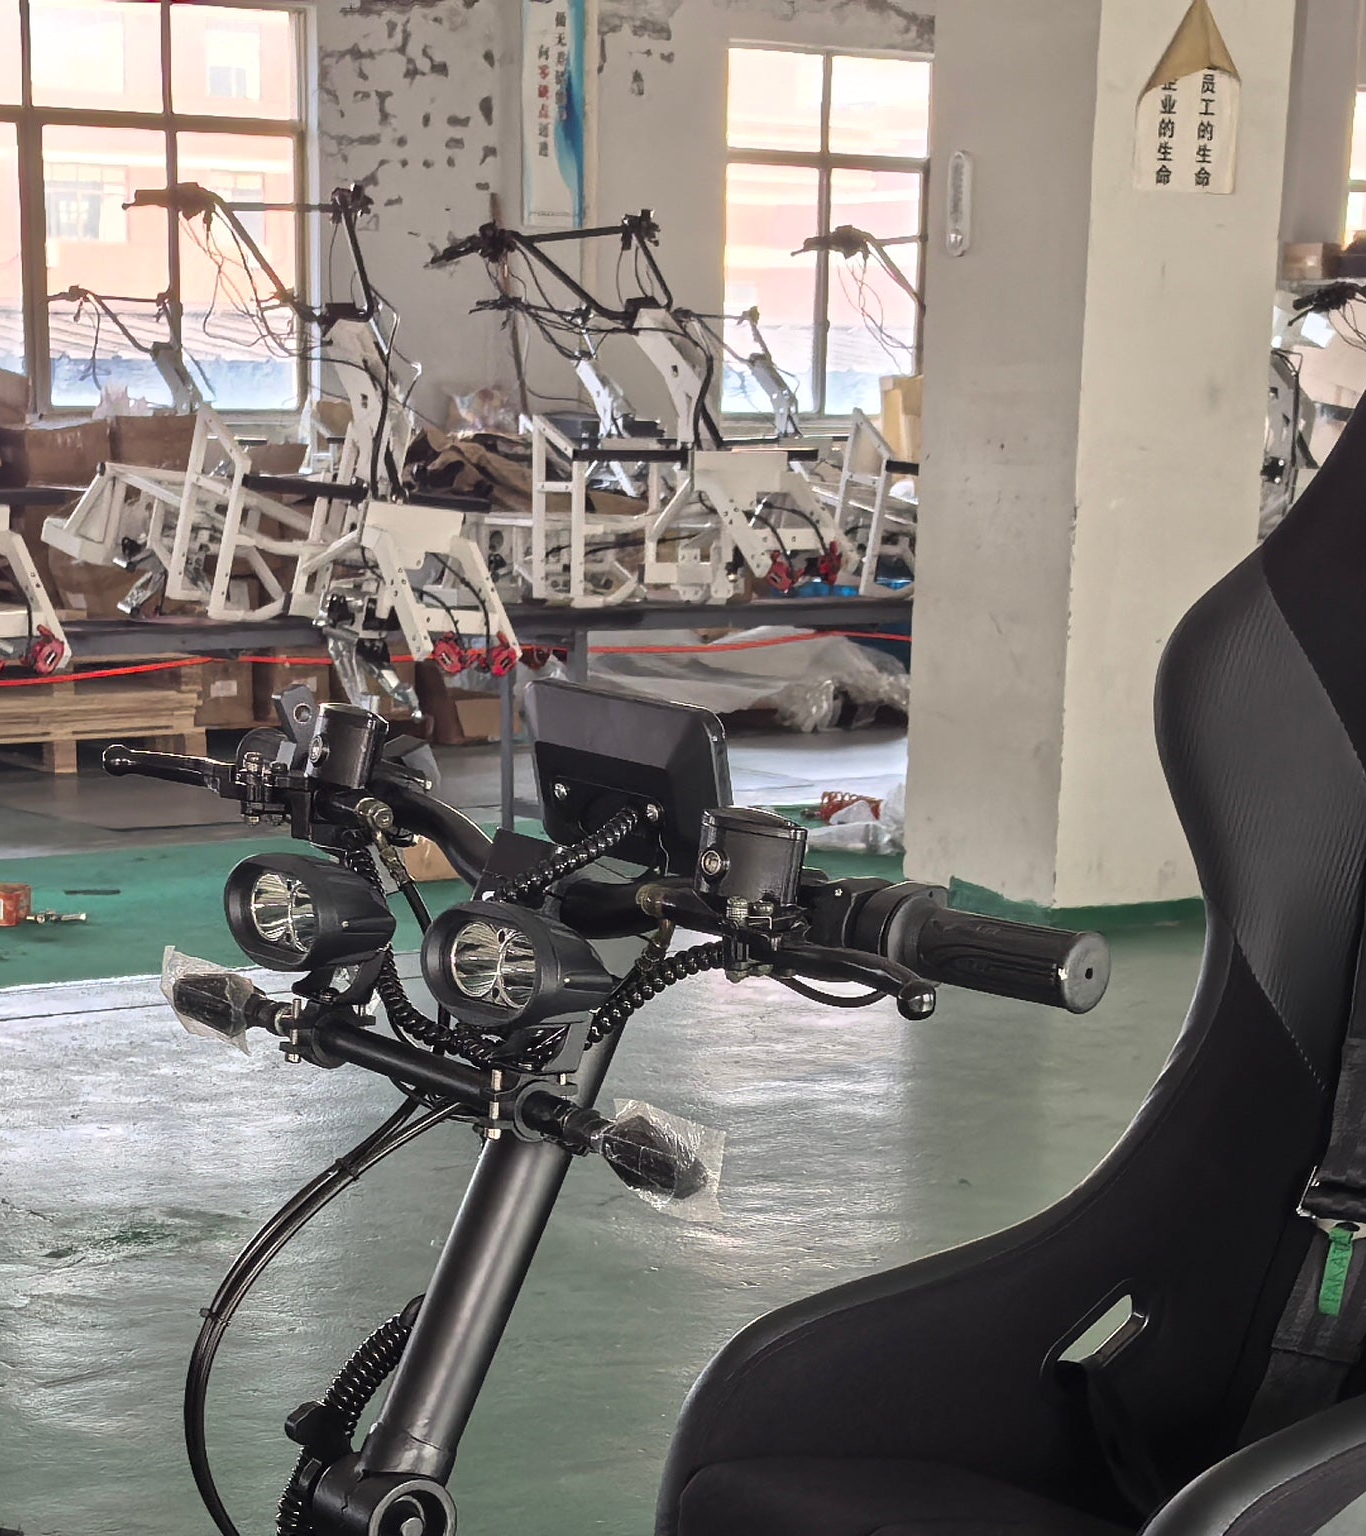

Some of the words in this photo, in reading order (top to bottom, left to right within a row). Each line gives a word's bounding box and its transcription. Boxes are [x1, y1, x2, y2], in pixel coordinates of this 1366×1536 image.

[1195, 73, 1216, 187] 员工的生命
